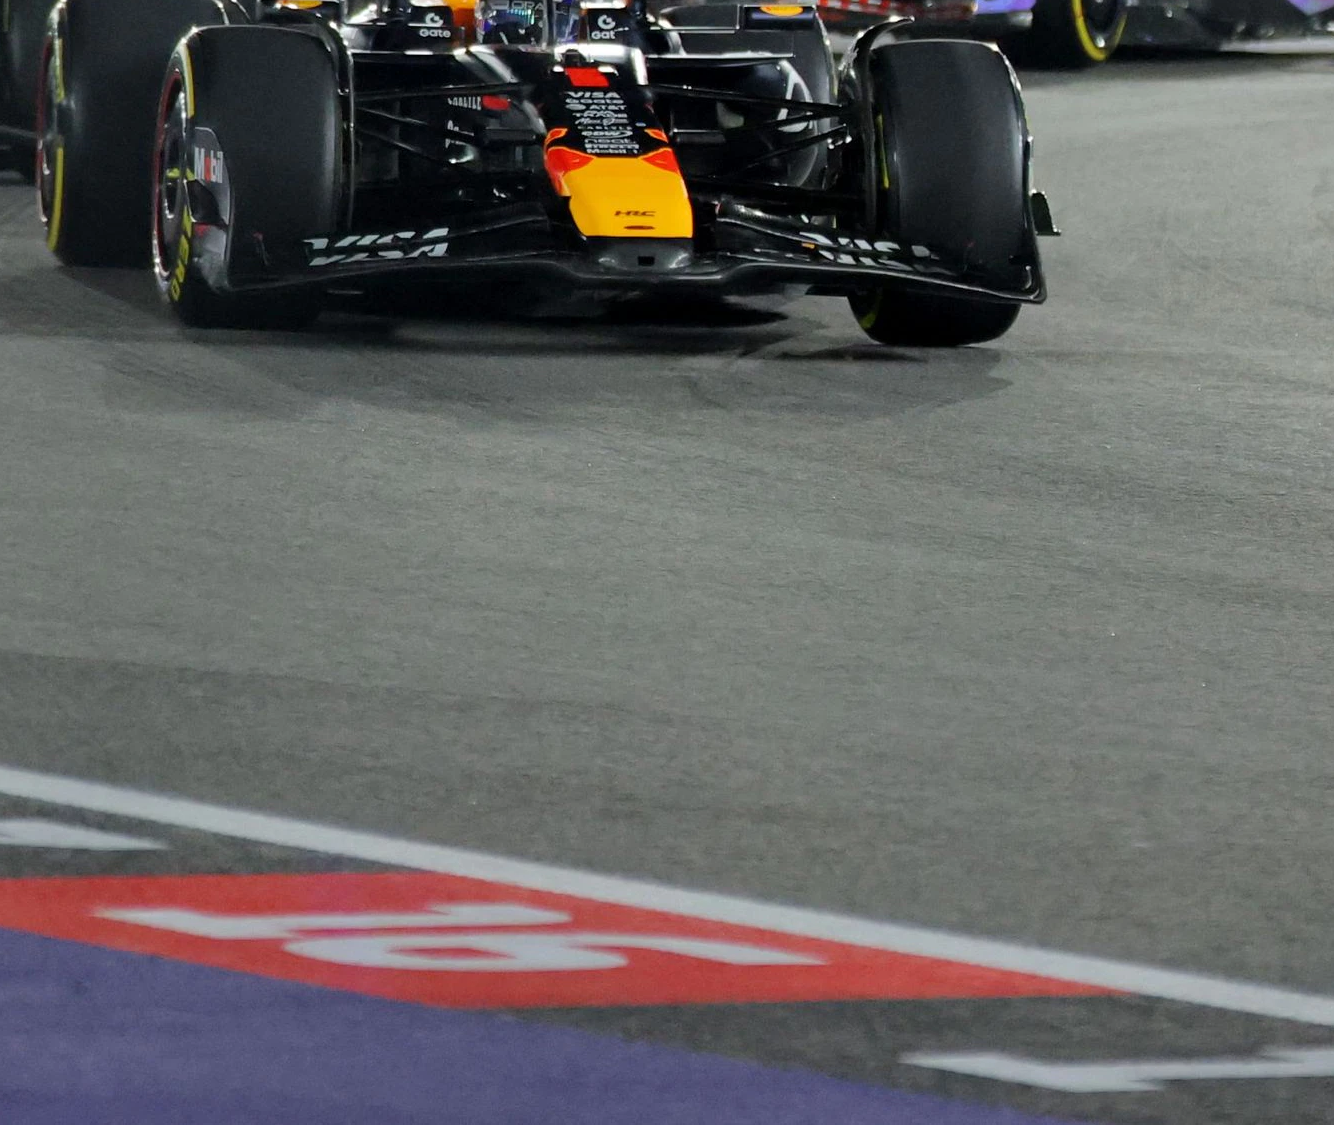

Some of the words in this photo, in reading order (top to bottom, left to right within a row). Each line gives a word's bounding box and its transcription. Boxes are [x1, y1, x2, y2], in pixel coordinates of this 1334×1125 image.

[510, 0, 545, 11] ORA
[419, 27, 451, 38] Gate
[591, 28, 617, 40] Gat
[614, 209, 657, 218] HRC
[91, 903, 817, 972] 16
